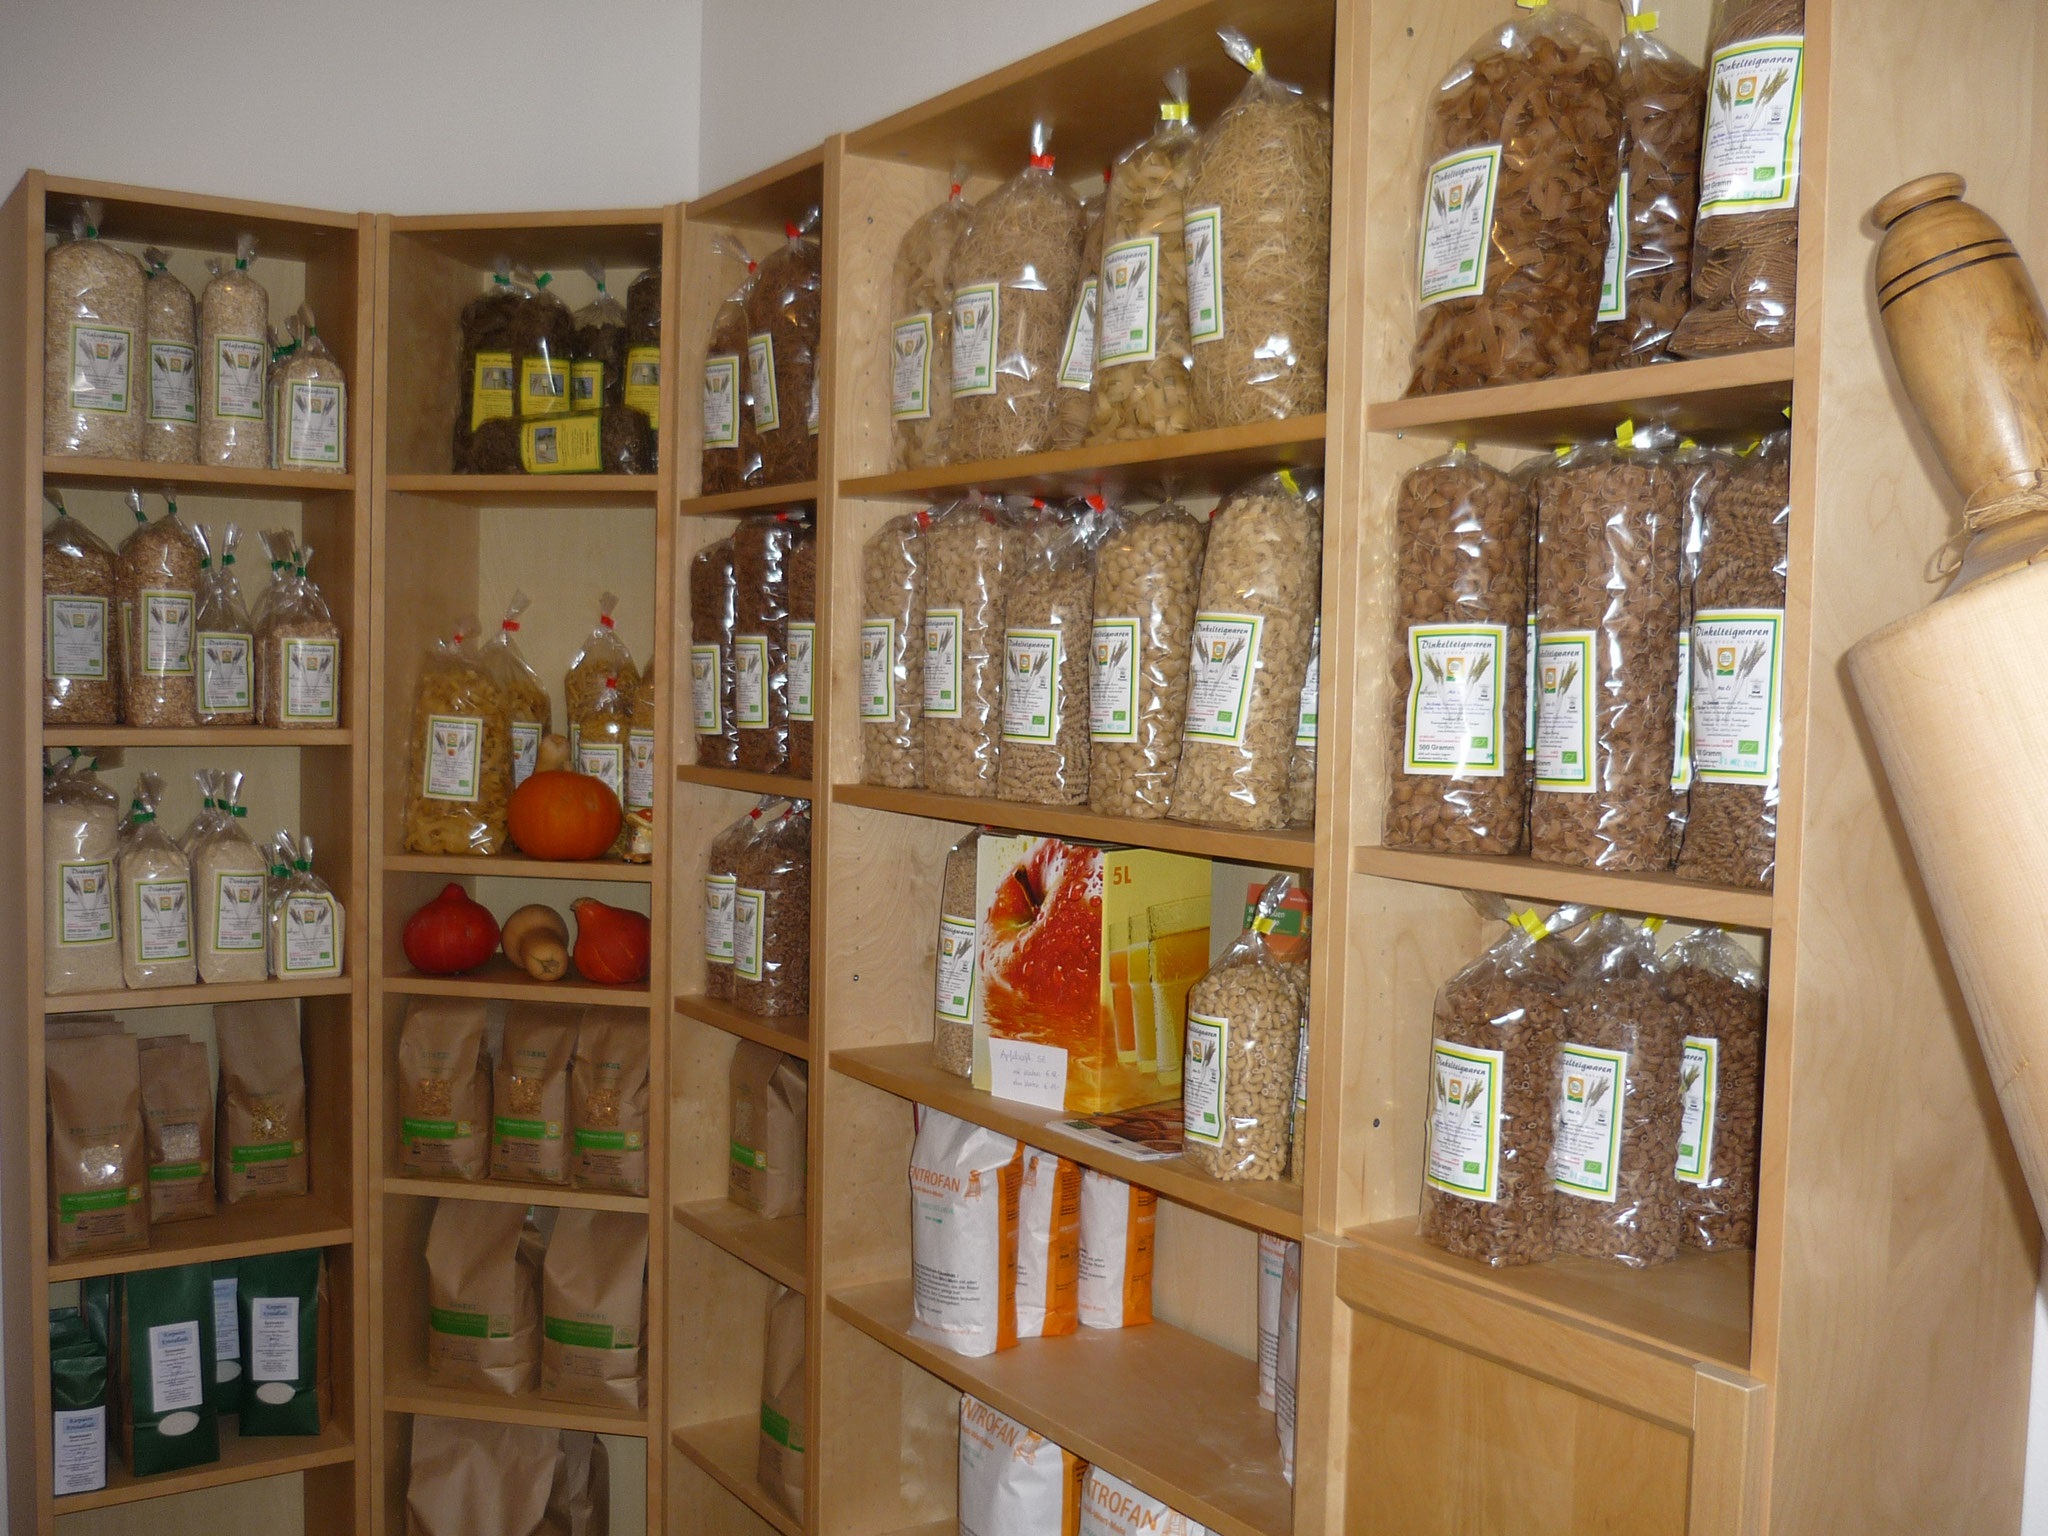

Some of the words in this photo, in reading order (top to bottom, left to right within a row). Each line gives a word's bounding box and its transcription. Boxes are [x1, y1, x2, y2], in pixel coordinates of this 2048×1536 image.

[1717, 56, 1794, 75] Dinkelteigwaren
[1434, 163, 1488, 185] Dinkelteigwaren
[1696, 626, 1769, 639] Dinkelteigwaren
[1421, 640, 1492, 651] Dinkelteigwaren
[1113, 866, 1132, 885] 5L
[1436, 1055, 1486, 1075] Dinkelteigwaren
